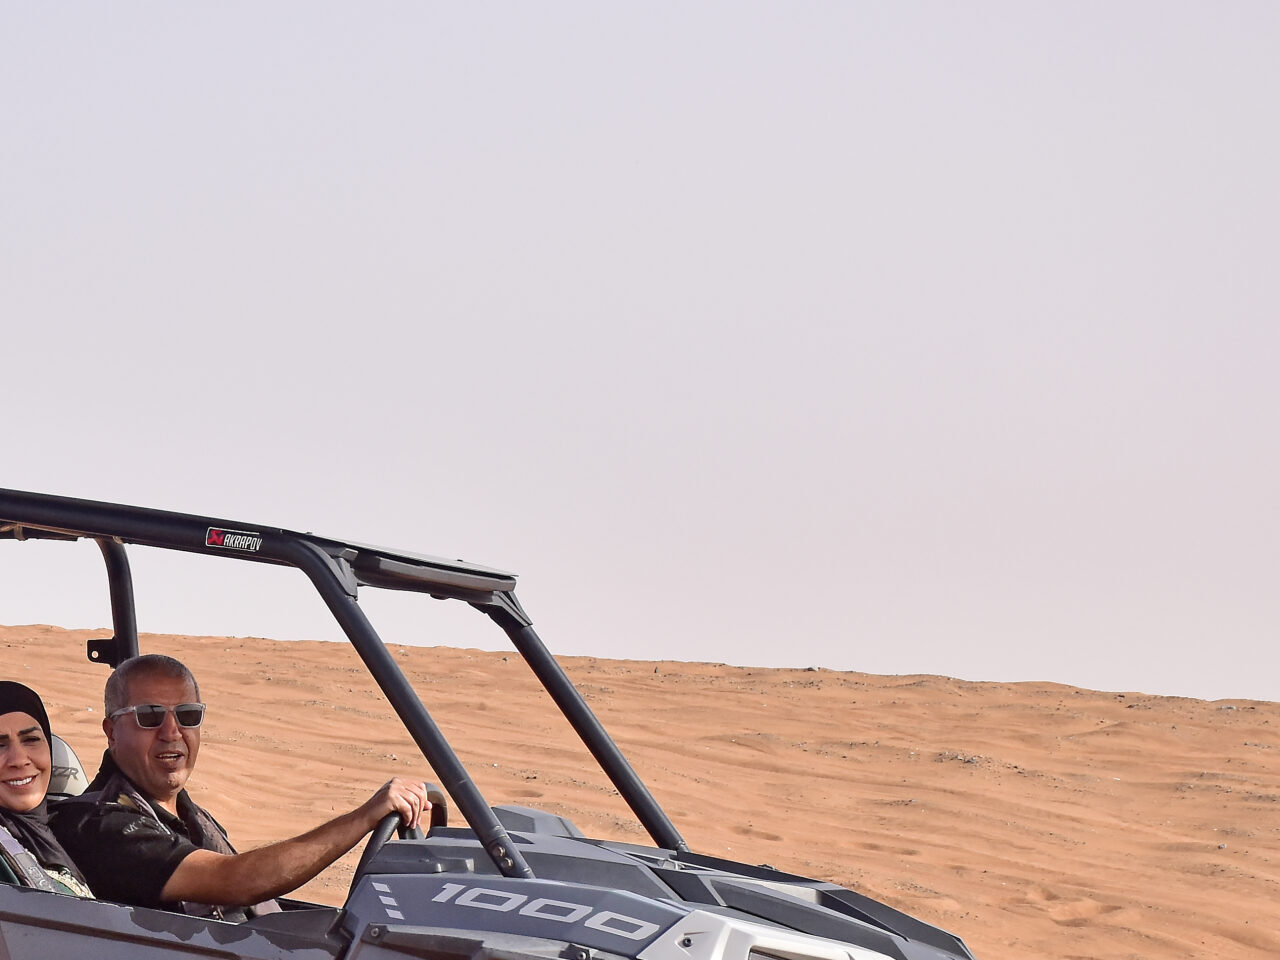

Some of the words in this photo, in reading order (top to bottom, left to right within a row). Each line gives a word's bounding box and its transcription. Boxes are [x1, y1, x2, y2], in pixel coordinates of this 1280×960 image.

[223, 533, 262, 551] AKRAPOV
[51, 765, 79, 781] ZR
[431, 882, 661, 941] 1000
